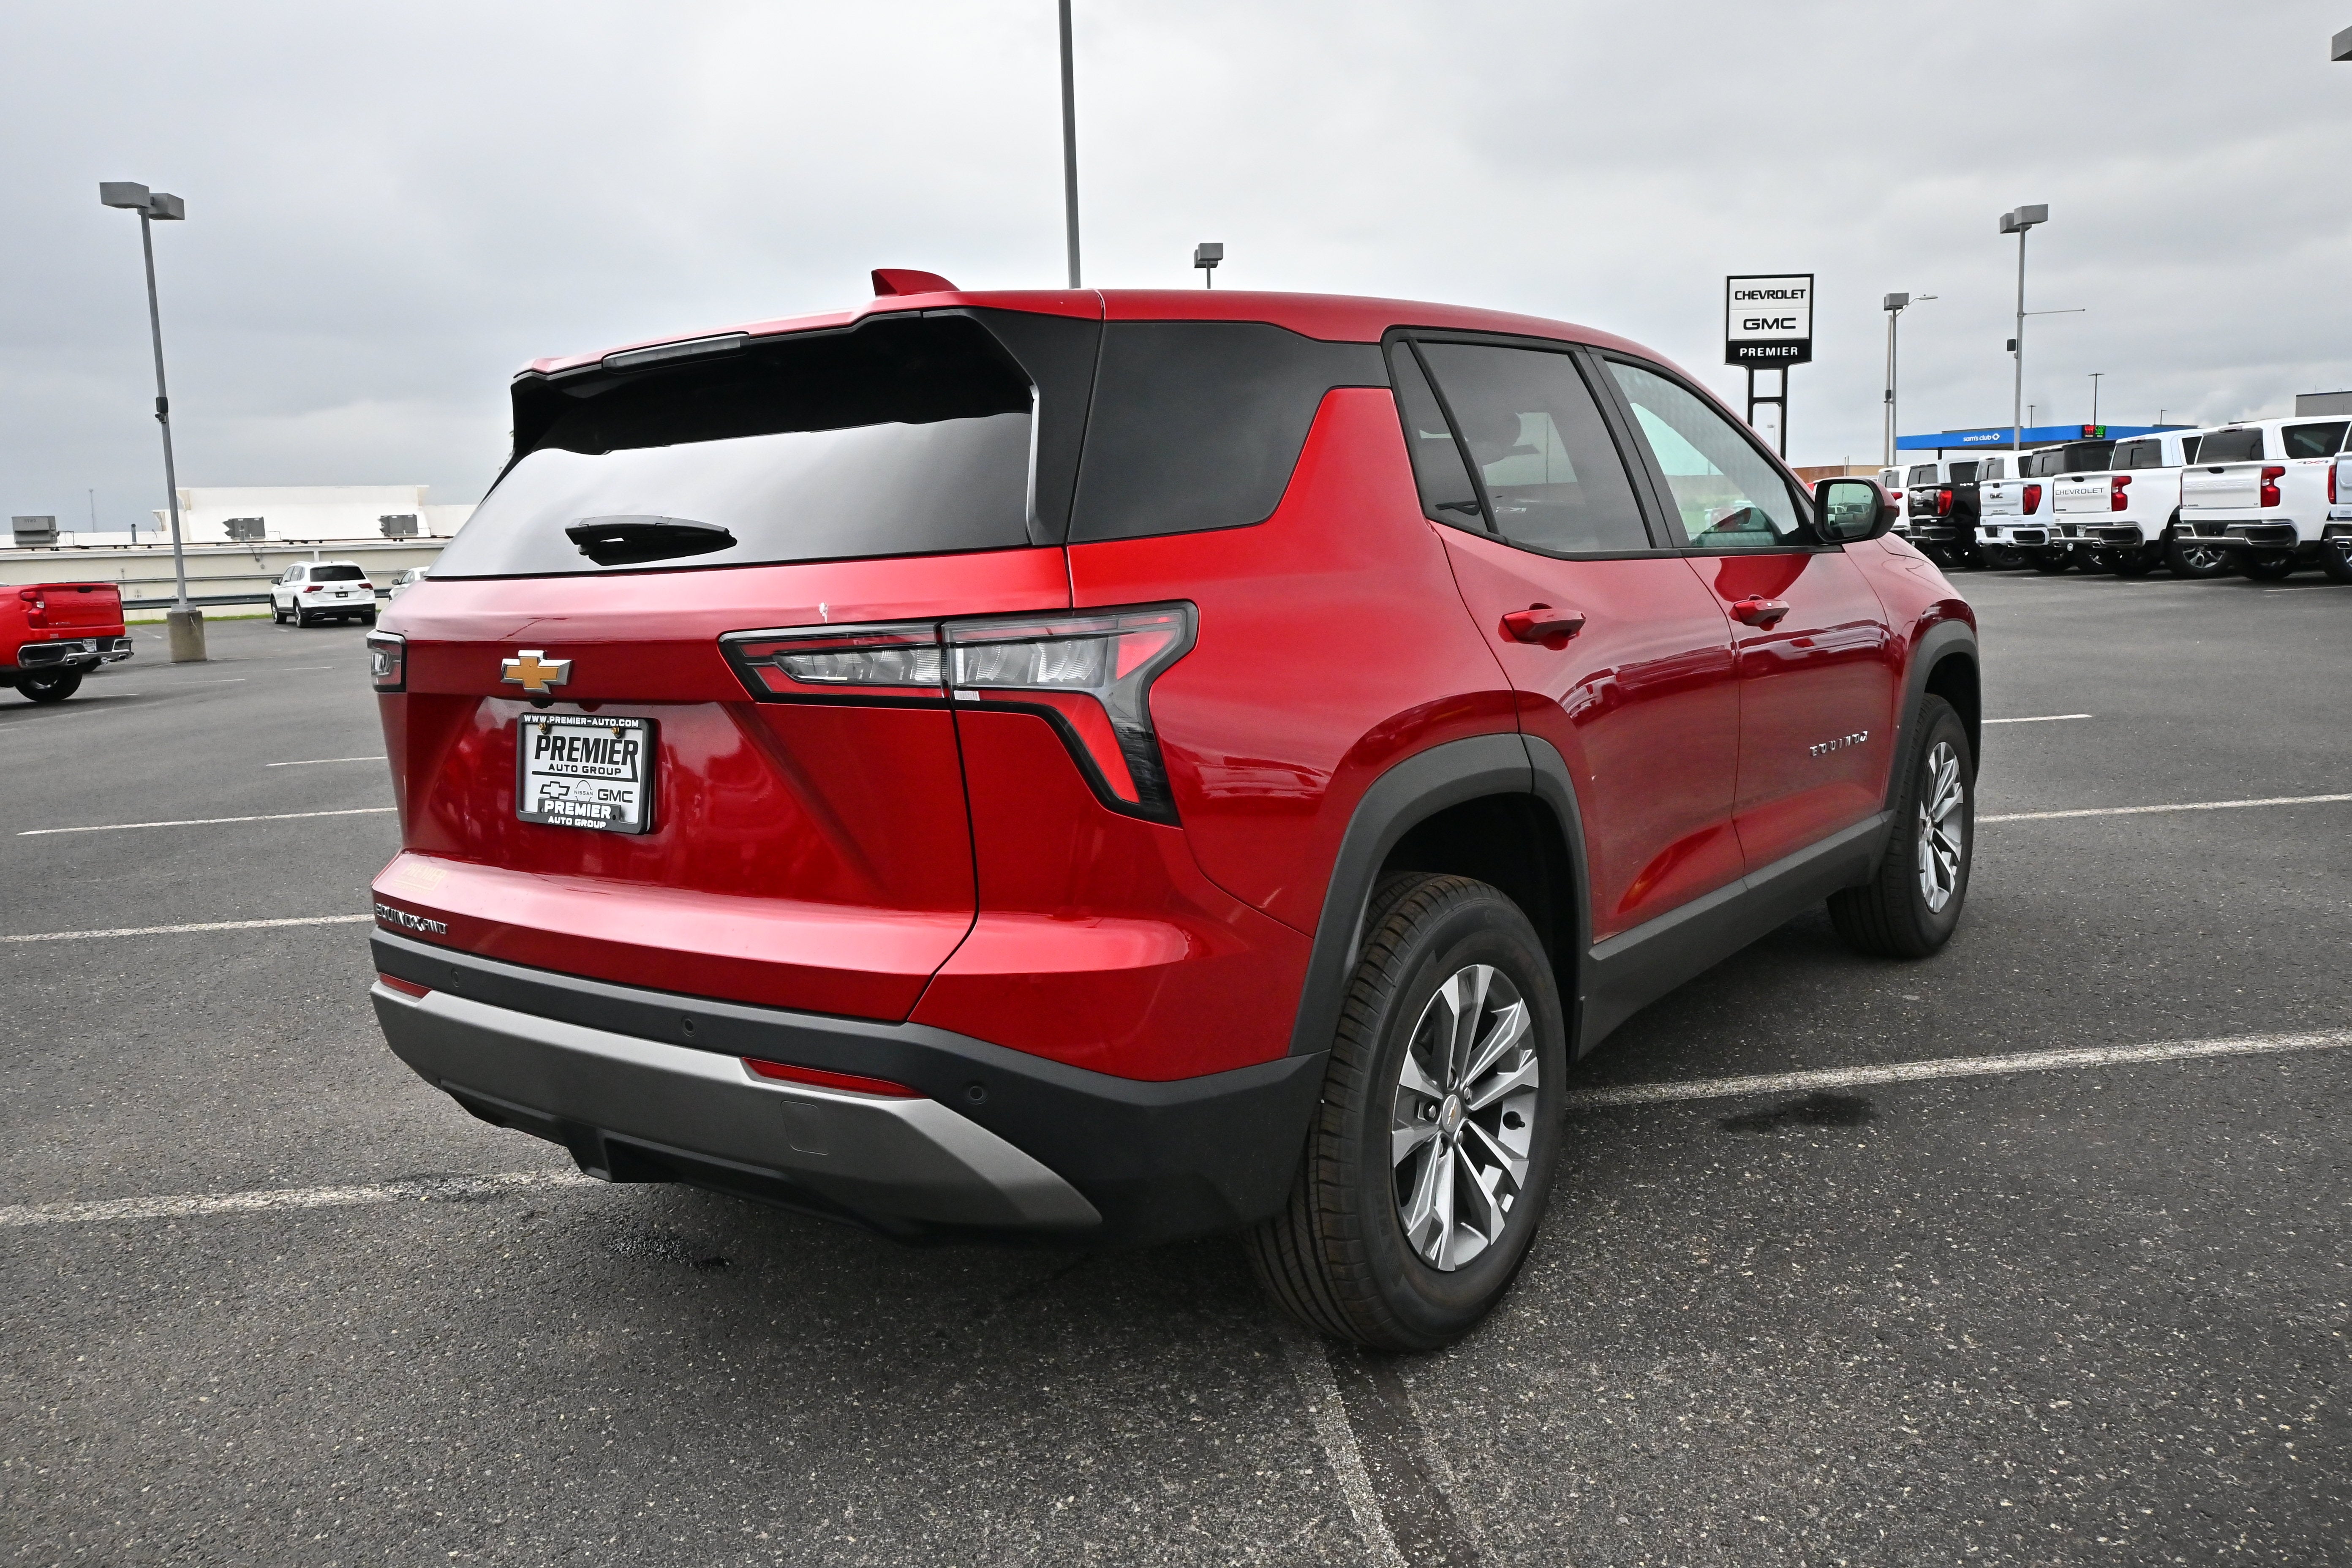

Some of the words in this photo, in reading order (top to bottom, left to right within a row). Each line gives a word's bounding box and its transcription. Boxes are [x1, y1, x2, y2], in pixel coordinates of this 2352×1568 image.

[1735, 289, 1806, 300] CHEVROLET
[1743, 318, 1796, 330] GMC
[1740, 347, 1798, 357] PREMIER
[524, 715, 639, 727] WWW.PREMIER-AUTO.COM
[534, 735, 639, 775] PREMIER
[548, 763, 578, 773] AUTO
[582, 766, 621, 776] GROUP
[598, 789, 633, 803] GMC
[544, 800, 611, 819] PREMIER
[548, 816, 572, 825] AUTO
[574, 819, 606, 828] GROUP
[402, 863, 448, 885] PREMIER
